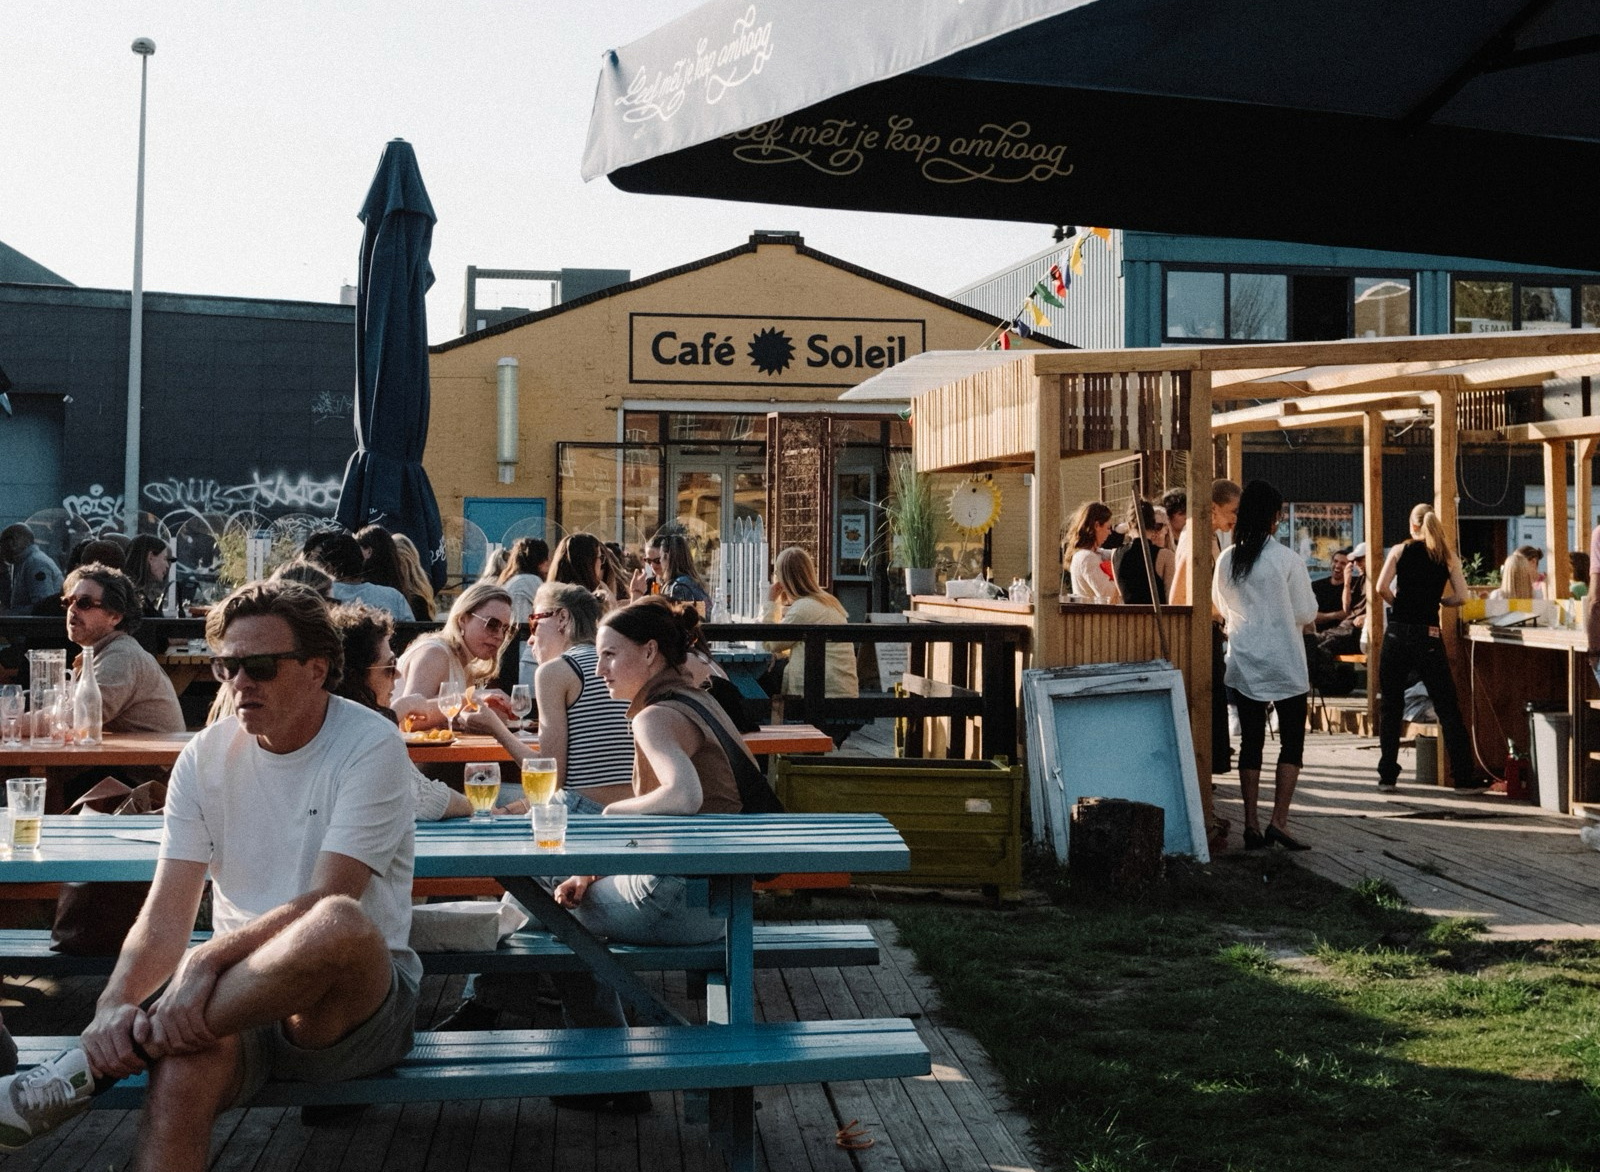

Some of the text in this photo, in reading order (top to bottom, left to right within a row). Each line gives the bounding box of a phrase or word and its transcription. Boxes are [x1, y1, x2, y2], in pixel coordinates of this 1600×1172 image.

[790, 119, 856, 147] met
[885, 115, 941, 162] kop
[948, 121, 1073, 182] omhoog
[651, 331, 906, 368] Café Soleil
